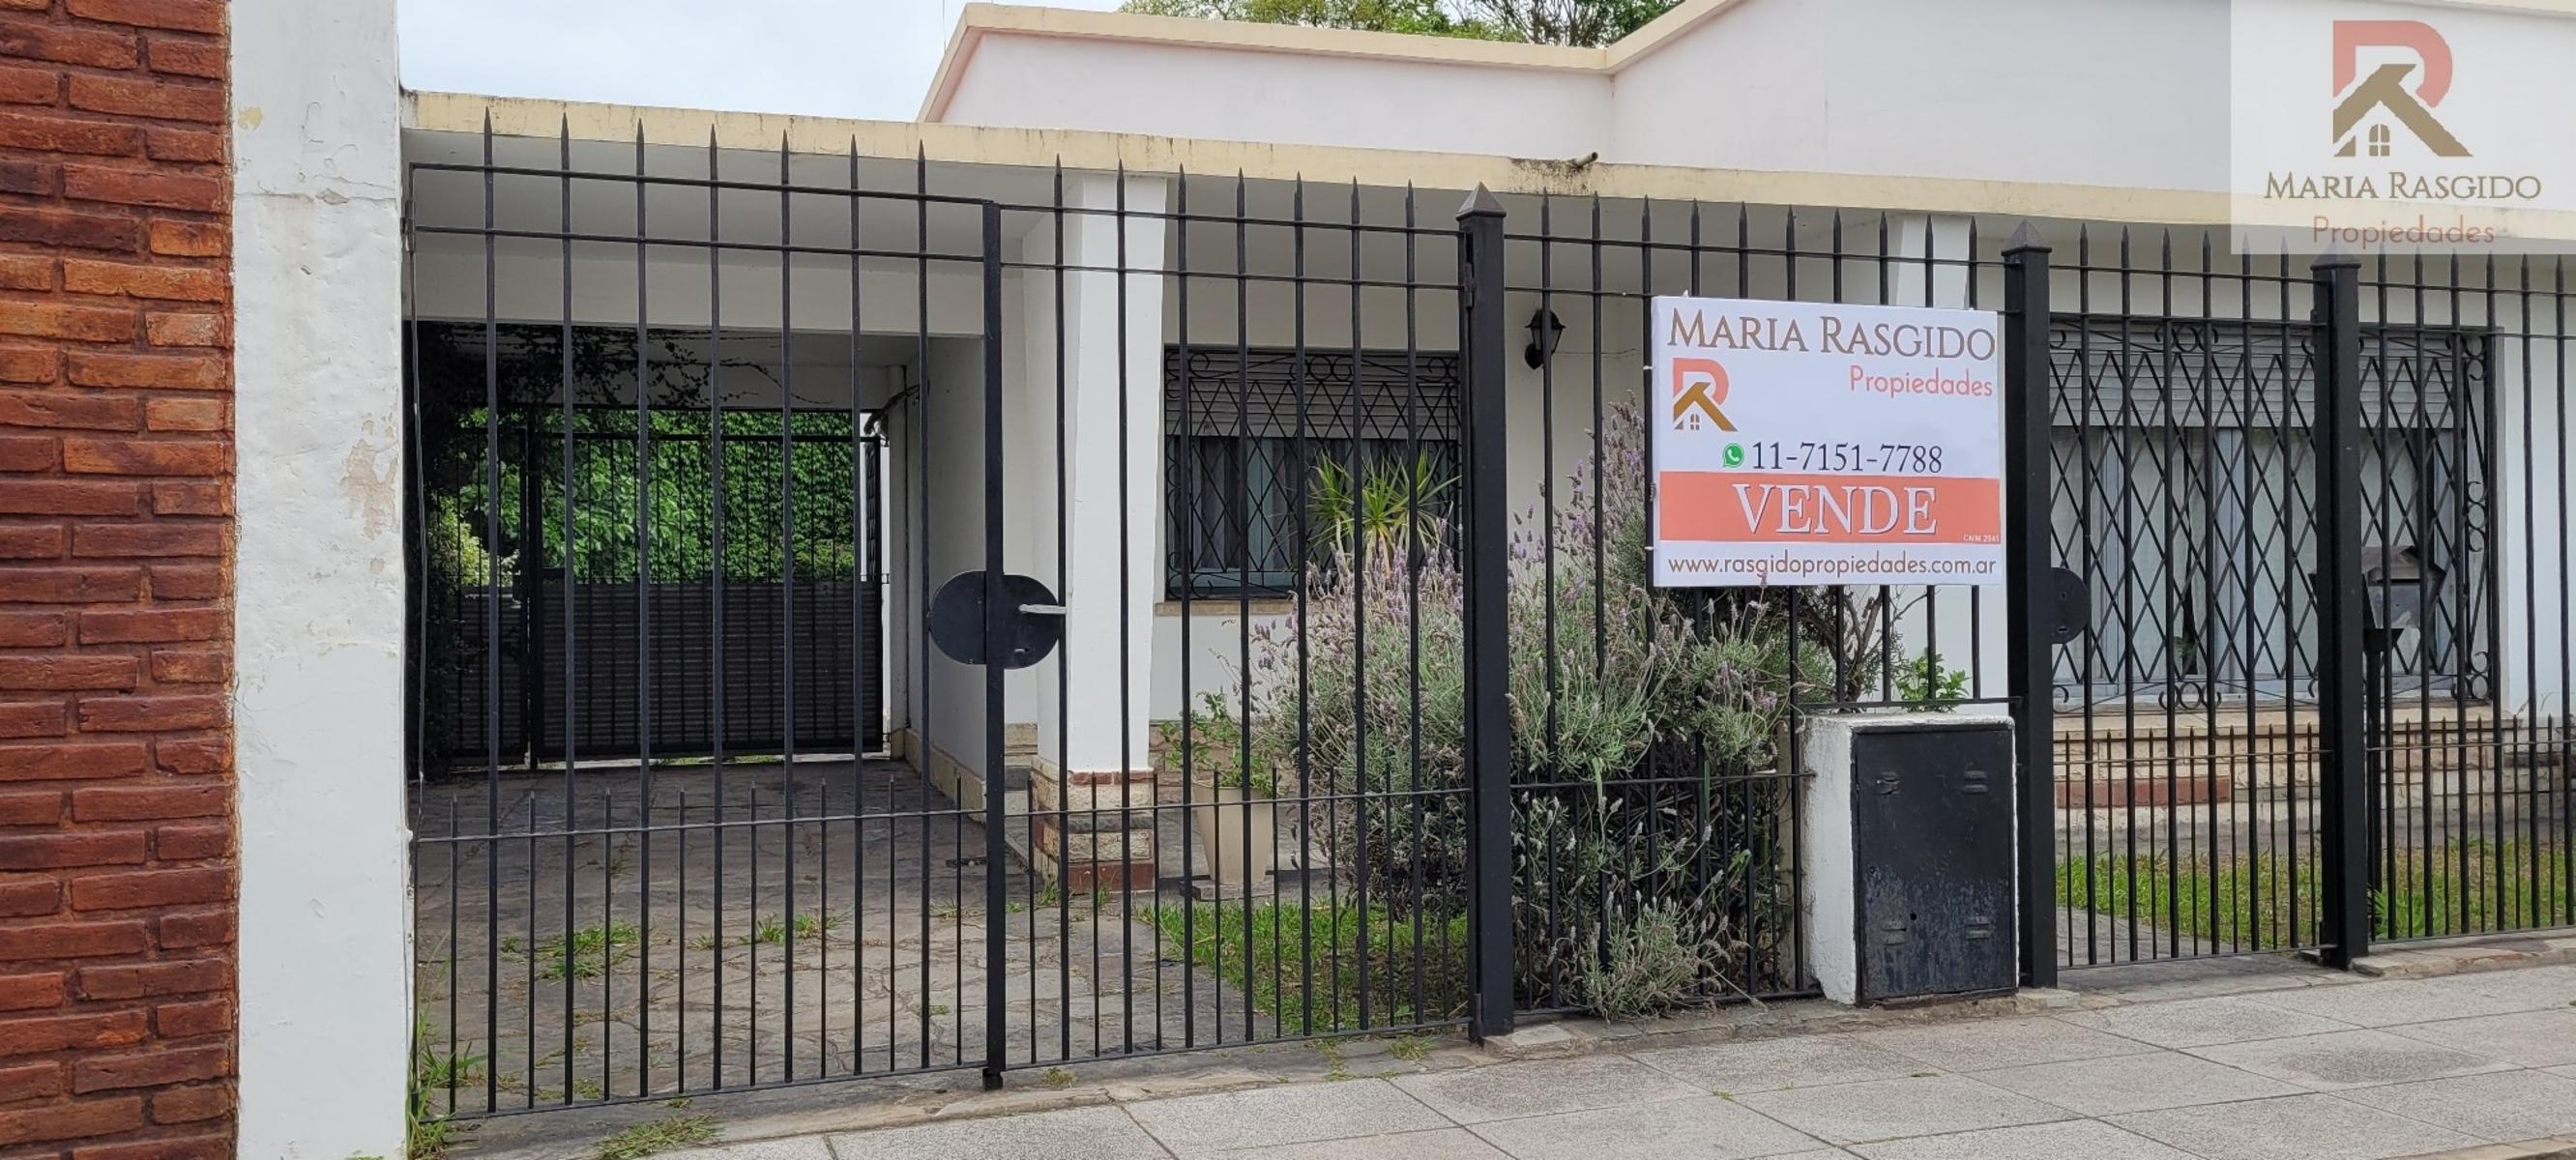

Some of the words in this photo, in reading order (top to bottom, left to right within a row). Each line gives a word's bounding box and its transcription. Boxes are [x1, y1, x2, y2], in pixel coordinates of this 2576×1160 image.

[1667, 307, 1809, 353] MARIA
[1820, 315, 1996, 361] RASGIDO
[1850, 364, 1993, 398] Propiedades
[1752, 442, 1943, 474] 11-7151-7788
[1732, 482, 1938, 535] VENDE
[1668, 548, 1996, 580] www.rasgidopropiedades.com.ar
